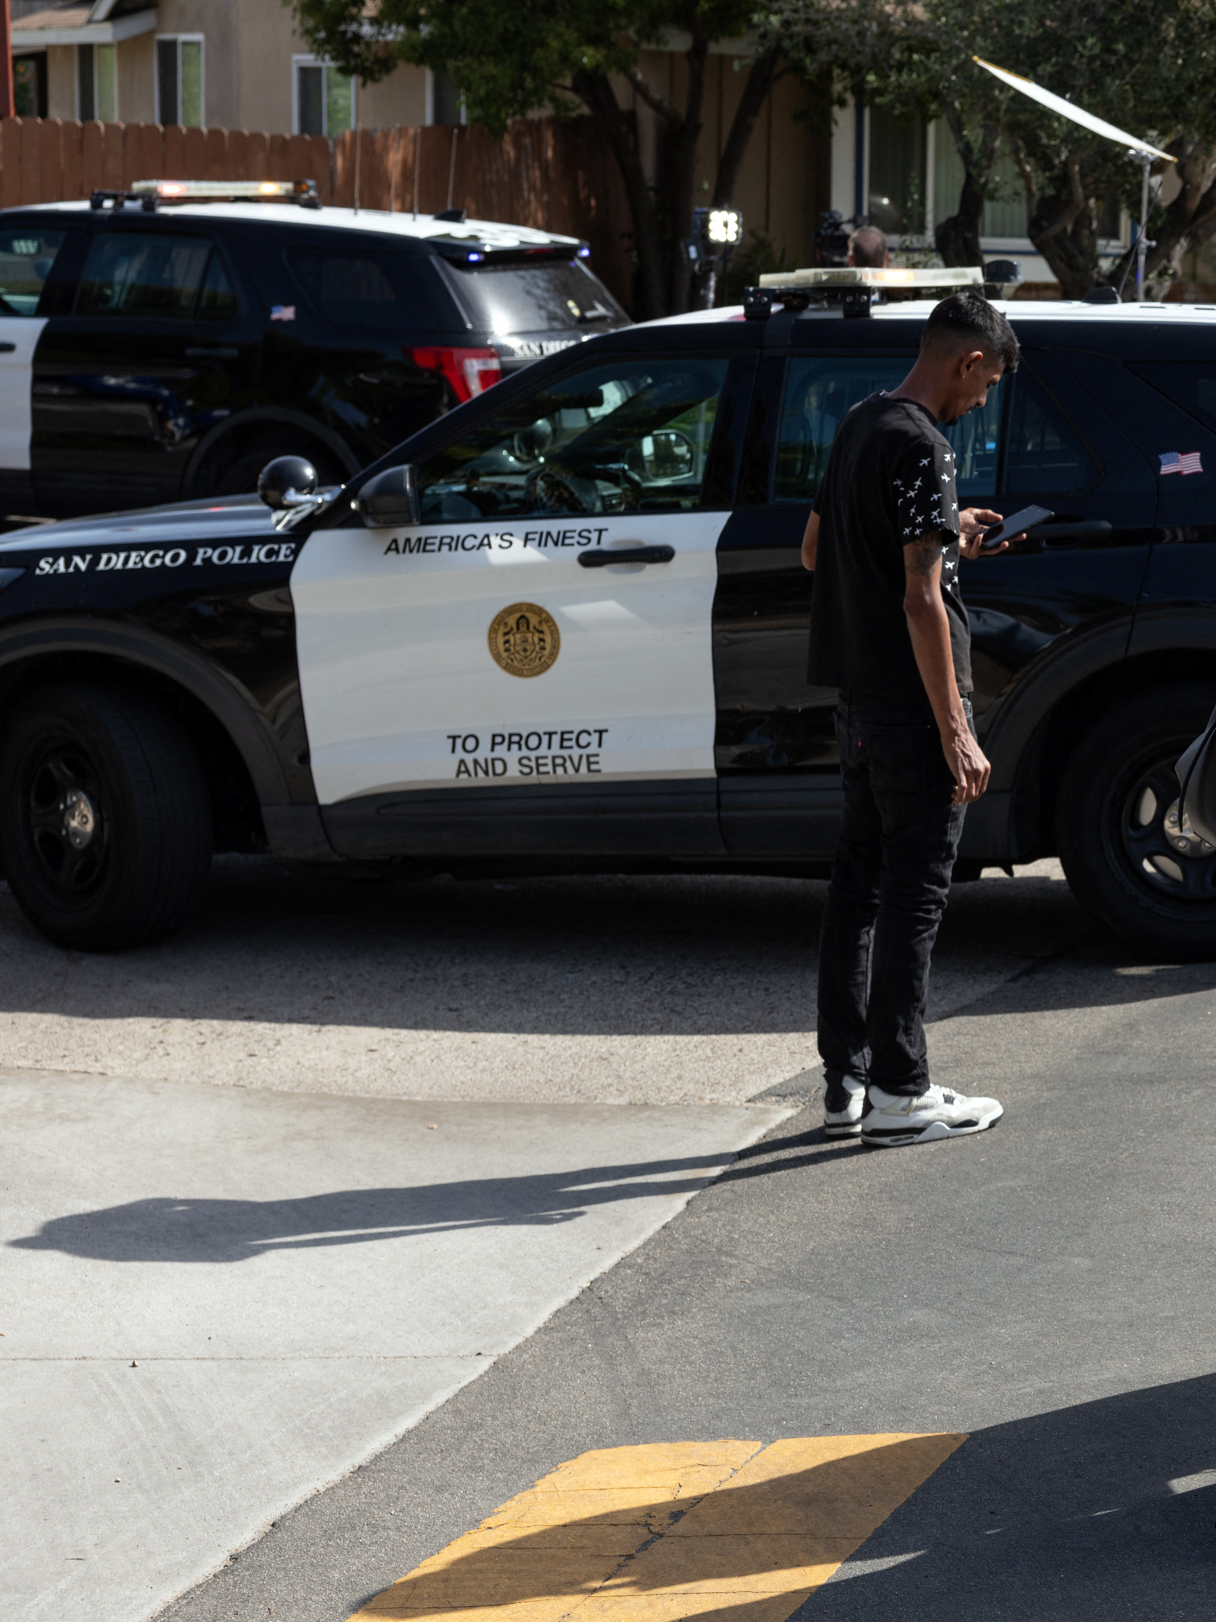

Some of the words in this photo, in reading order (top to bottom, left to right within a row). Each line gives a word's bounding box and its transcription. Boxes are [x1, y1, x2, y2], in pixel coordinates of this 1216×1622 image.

[514, 341, 542, 357] SAN
[383, 532, 515, 556] AMERICA'S
[522, 528, 609, 548] FINEST
[35, 554, 93, 575] SAN
[95, 549, 187, 572] DIEGO
[192, 543, 296, 567] POLICE
[447, 733, 480, 754] TO
[490, 728, 609, 752] PROTECT
[455, 757, 508, 779] AND
[517, 753, 602, 777] SERVE
